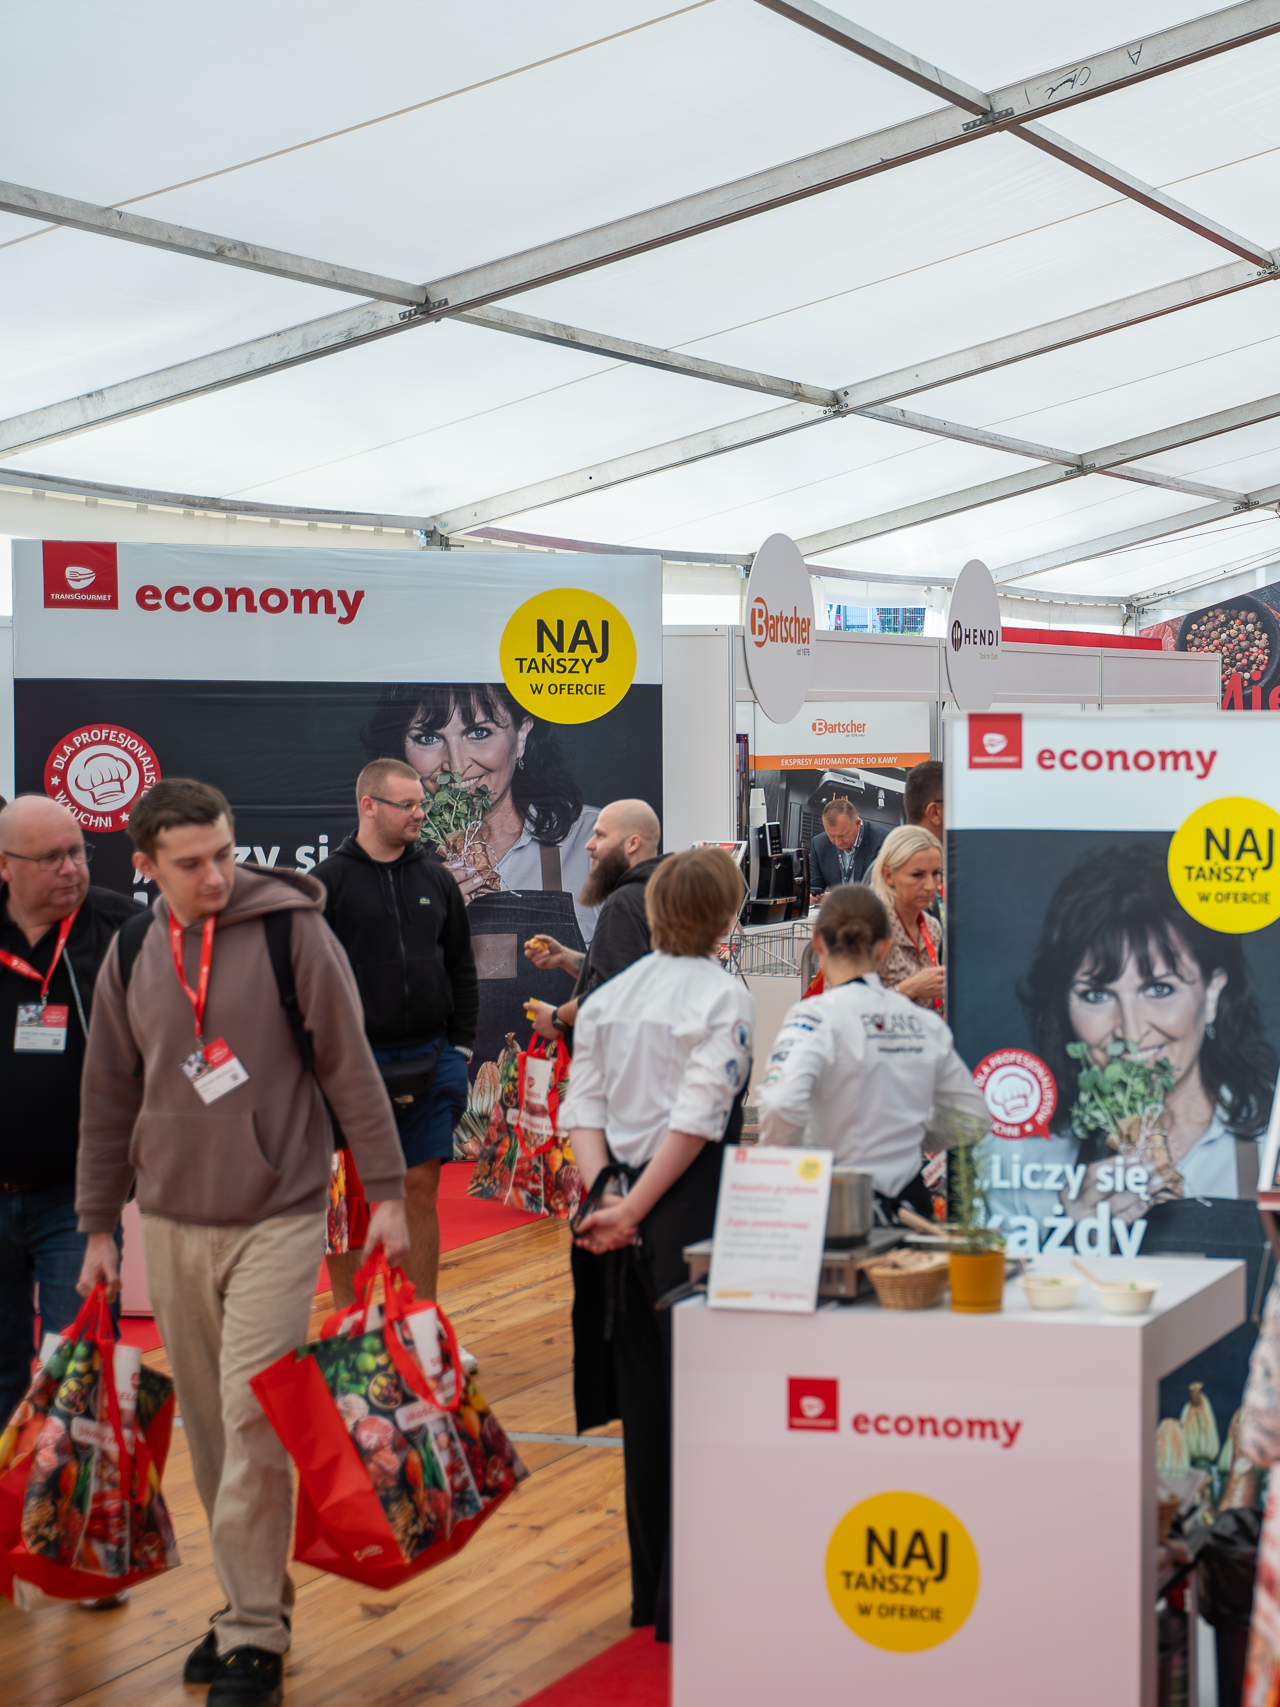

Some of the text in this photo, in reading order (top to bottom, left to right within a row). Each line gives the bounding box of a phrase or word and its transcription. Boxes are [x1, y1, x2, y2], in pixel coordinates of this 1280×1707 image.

[50, 592, 112, 601] TRANSGOURMET
[136, 583, 365, 625] economy
[750, 596, 811, 648] Bartscher
[536, 618, 609, 663] NAJ
[964, 627, 998, 646] HENDI
[514, 653, 594, 674] TAŃSZY
[529, 683, 606, 695] W OFERCIE
[811, 718, 866, 736] Bartscher
[53, 745, 75, 769] DLA
[781, 758, 812, 766] EKSPRESY
[813, 757, 865, 765] AUTOMATYCZNE
[878, 756, 898, 764] KAWY
[1037, 748, 1218, 780] economy
[1205, 827, 1273, 871] NAJ
[1183, 861, 1258, 882] TAŃSZY
[1196, 891, 1272, 904] W OFERCIE
[1095, 1155, 1151, 1201] się
[852, 1412, 1022, 1450] economy
[866, 1525, 949, 1582] NAJ
[841, 1566, 931, 1596] TAŃSZY
[856, 1602, 945, 1624] W OFERCIE
